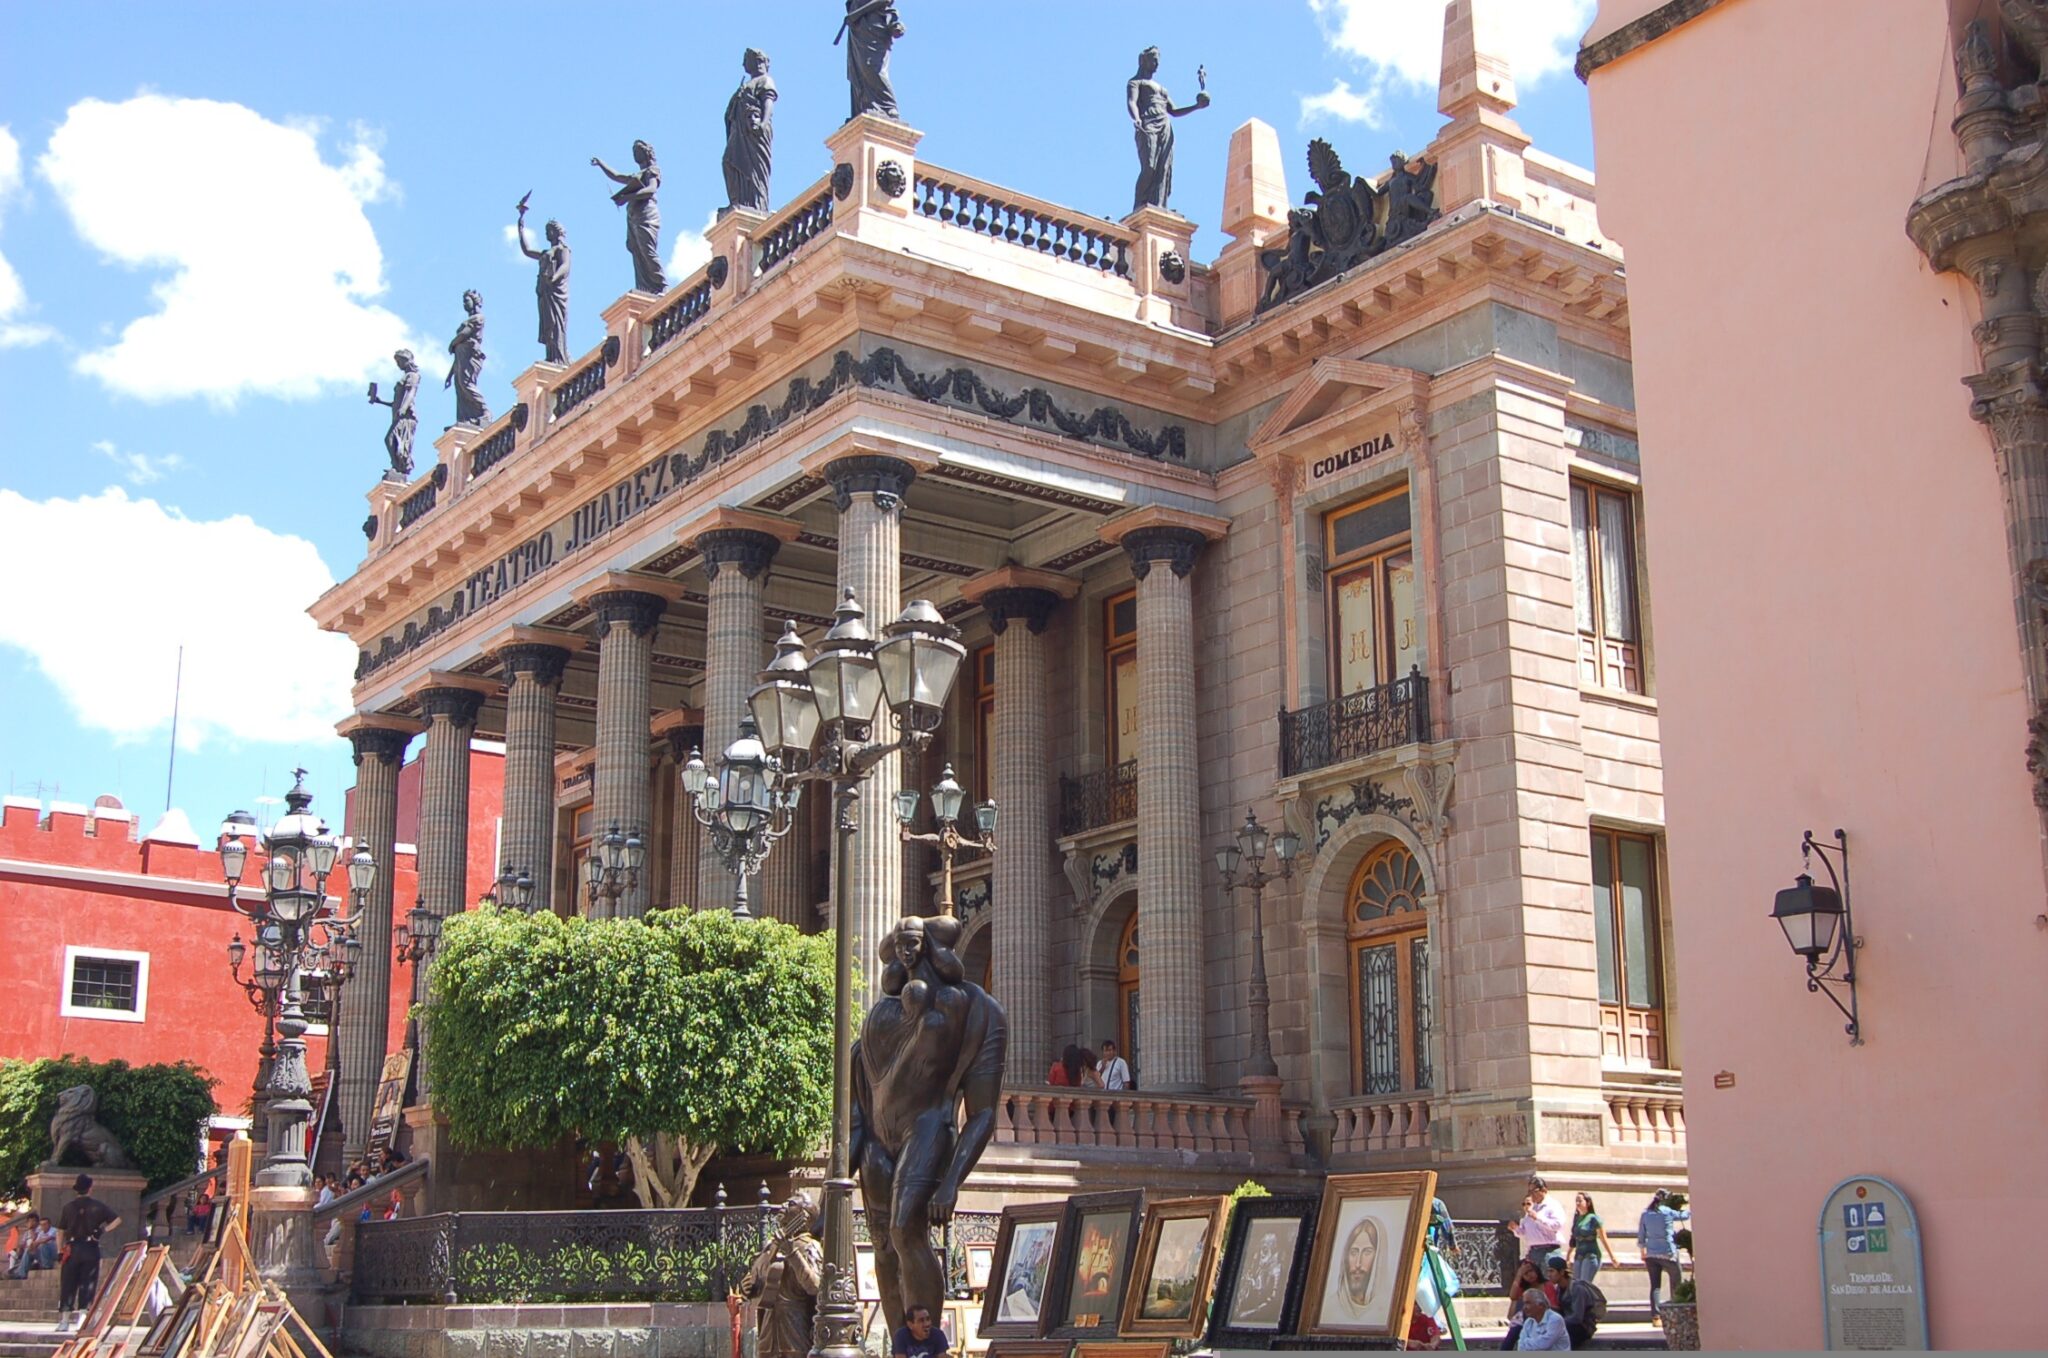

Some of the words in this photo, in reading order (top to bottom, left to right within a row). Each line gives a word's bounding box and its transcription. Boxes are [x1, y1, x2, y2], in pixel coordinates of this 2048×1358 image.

[1313, 432, 1395, 479] COMEDIA
[466, 531, 553, 612] TEATRO
[565, 454, 670, 553] JUAREZ
